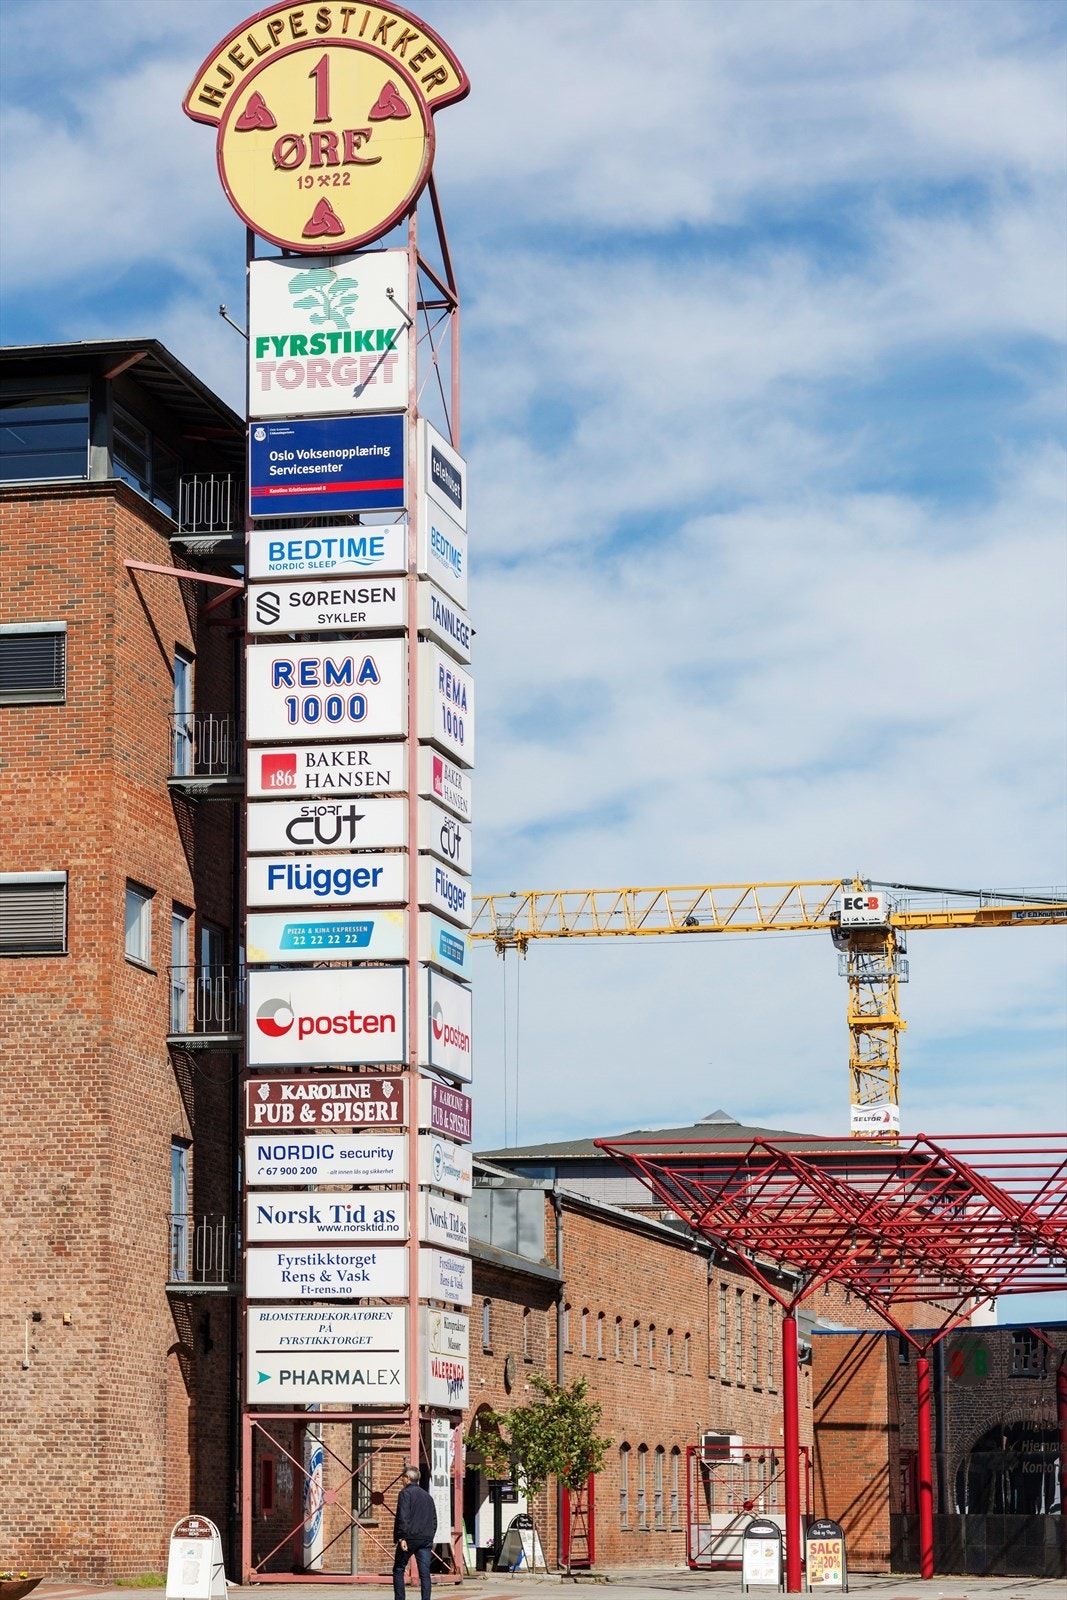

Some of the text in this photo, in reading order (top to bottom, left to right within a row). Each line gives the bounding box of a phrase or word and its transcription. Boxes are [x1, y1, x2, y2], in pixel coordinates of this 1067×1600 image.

[198, 7, 449, 108] HJELPESTIKKER
[308, 53, 332, 124] 1
[272, 127, 382, 171] ØRE
[255, 328, 397, 358] FYRSTIKK
[255, 353, 399, 391] TORGET
[269, 445, 391, 461] Oslo Voksenopplæring
[269, 463, 343, 476] Servicesenter
[268, 536, 385, 561] BEDTIME
[431, 526, 462, 572] BEDTIME
[268, 560, 337, 571] NORDIC SLEEP
[289, 587, 396, 607] SØRENSEN
[317, 612, 366, 624] SYKLER
[431, 595, 469, 650] TANNLEGE
[272, 655, 380, 689] REMA
[439, 664, 467, 713] REMA
[286, 693, 368, 725] 1000
[442, 703, 464, 746] 1000
[305, 750, 371, 767] BAKER
[305, 770, 391, 788] HANSEN
[444, 764, 463, 790] BAKER
[444, 785, 468, 813] HANSEN
[300, 805, 342, 816] SHORT
[267, 864, 383, 896] Flügger
[435, 867, 467, 912] Flügger
[844, 897, 879, 910] EC-B
[315, 926, 330, 934] KINA
[332, 925, 368, 933] EXPRESSEN
[293, 935, 358, 945] 22 22 22 22
[299, 1010, 396, 1040] posten
[443, 1024, 469, 1053] posten
[280, 1083, 370, 1100] KAROLINE
[439, 1090, 463, 1111] KAROLINE
[253, 1101, 398, 1123] PUB & SPISERI
[432, 1105, 443, 1126] PUB
[450, 1112, 470, 1136] SPISERI
[257, 1145, 394, 1160] NORDIC security
[266, 1166, 318, 1175] 67 900 200
[257, 1204, 395, 1224] Norsk Tid as
[429, 1206, 467, 1235] Norsk Tid as
[317, 1223, 400, 1233] www.norsktid.no
[277, 1253, 376, 1268] Fyrstikktorget
[281, 1269, 370, 1282] Rens & Vask
[301, 1284, 352, 1294] Ft-rens.no
[259, 1312, 393, 1321] BLOMSTERDEKORATØREN
[318, 1323, 333, 1333] PÅ
[279, 1336, 374, 1345] FYRSTIKKTORGET
[279, 1369, 400, 1385] PHARMALEX
[431, 1357, 464, 1381] VÅLERENGA
[810, 1543, 839, 1554] SALG
[824, 1556, 840, 1568] 20%
